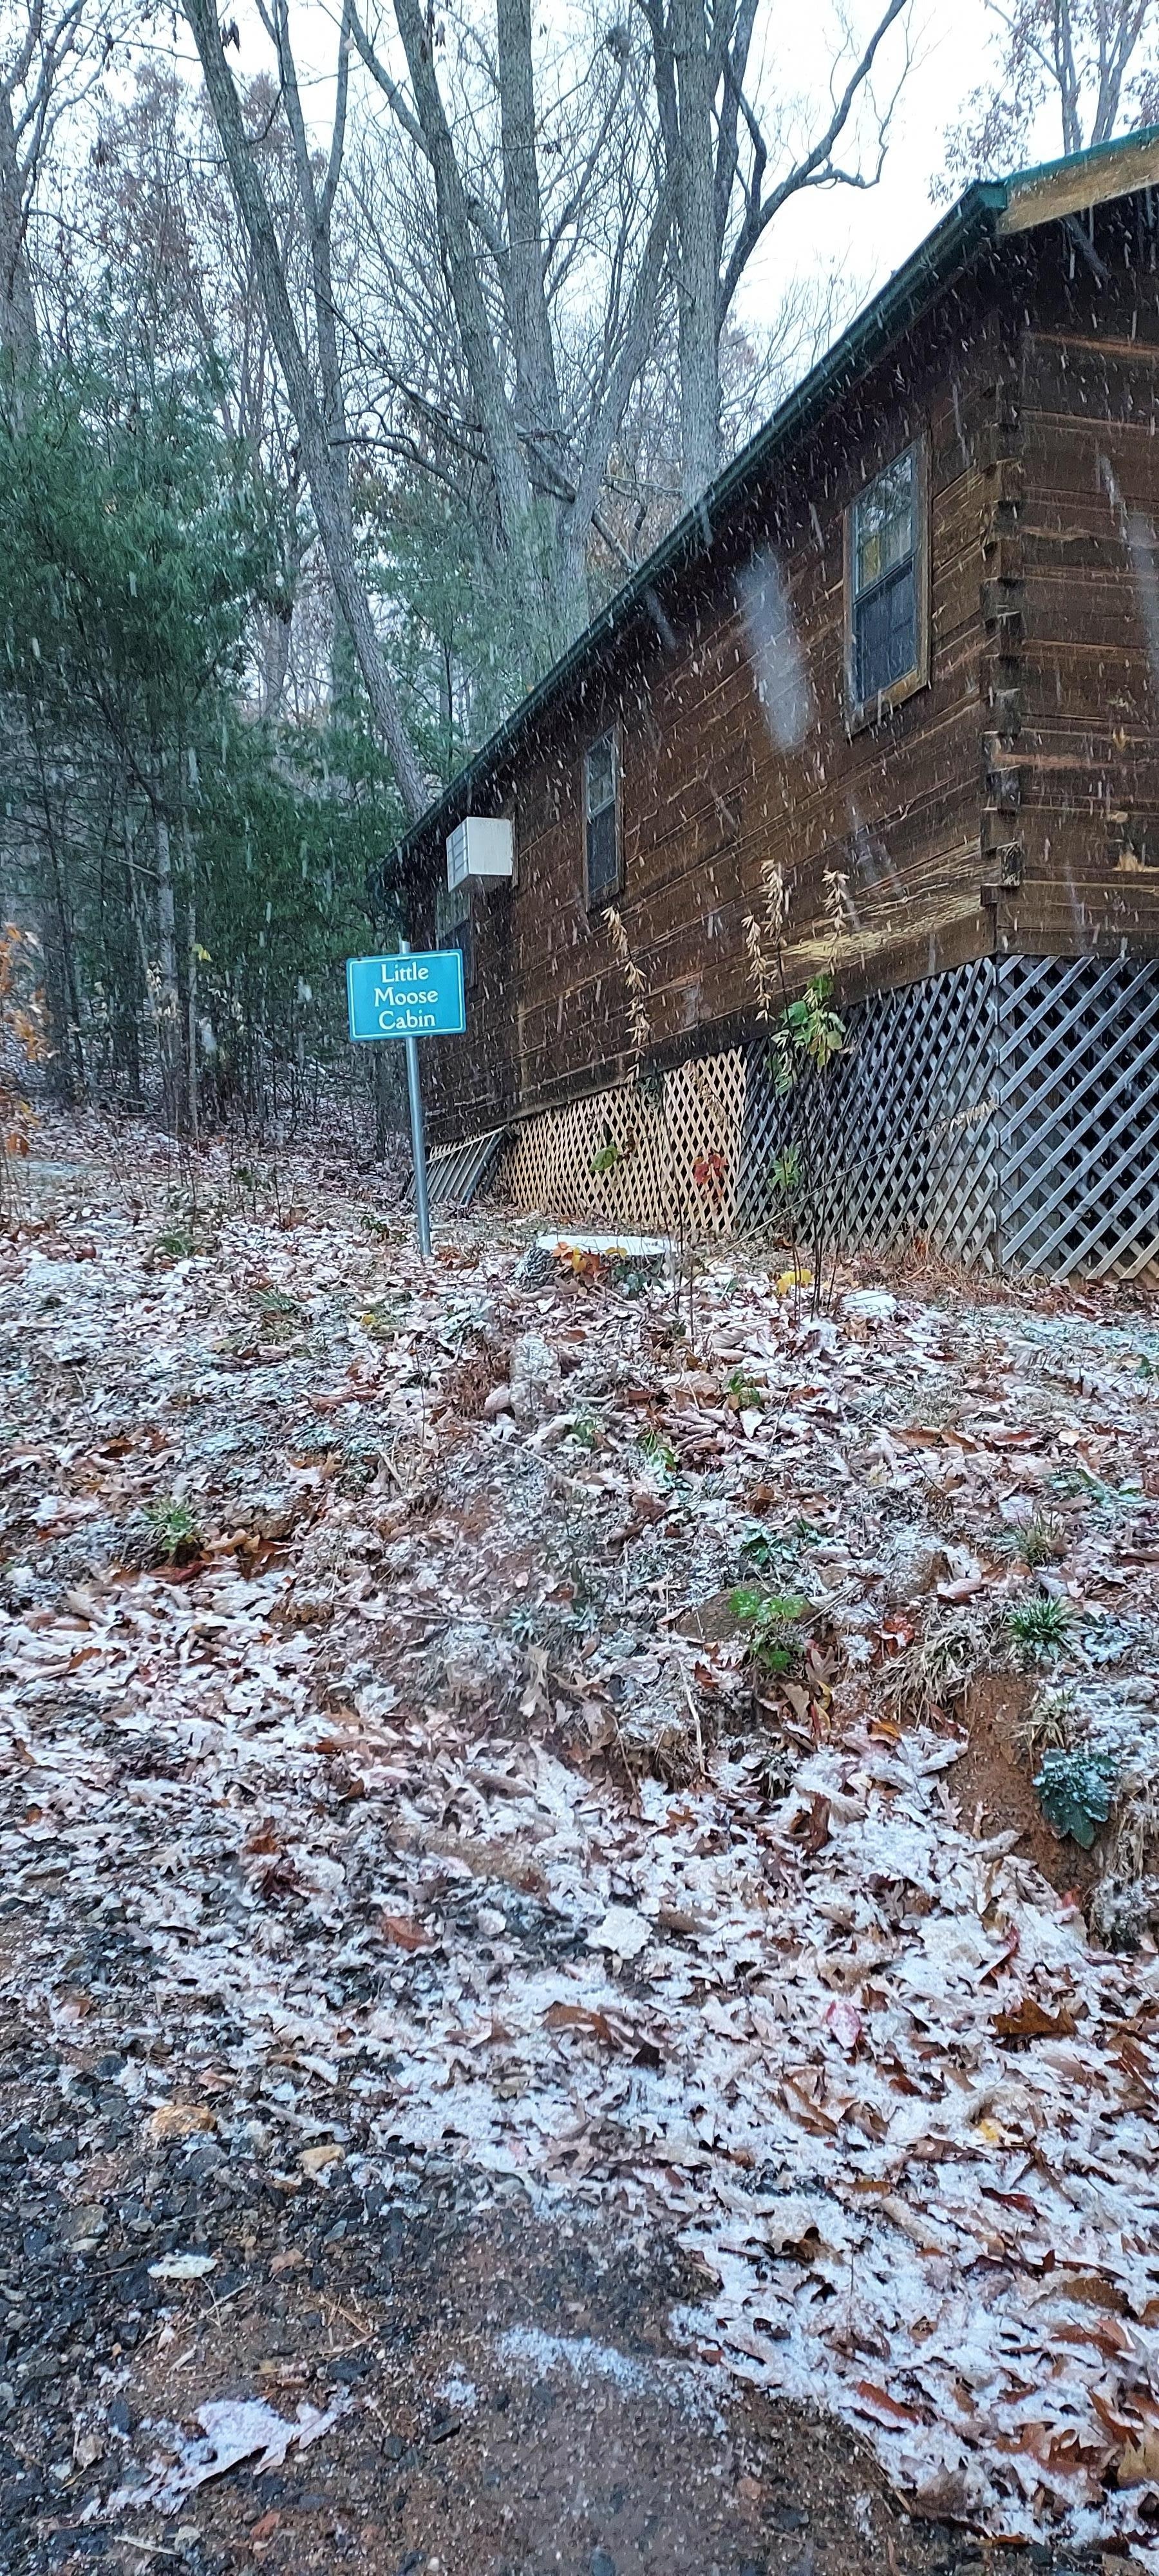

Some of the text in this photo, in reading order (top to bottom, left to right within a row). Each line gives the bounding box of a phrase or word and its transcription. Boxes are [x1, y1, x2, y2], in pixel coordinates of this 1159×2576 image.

[381, 961, 429, 983] Little
[374, 987, 438, 1007] Moose
[379, 1009, 436, 1030] Cabin
